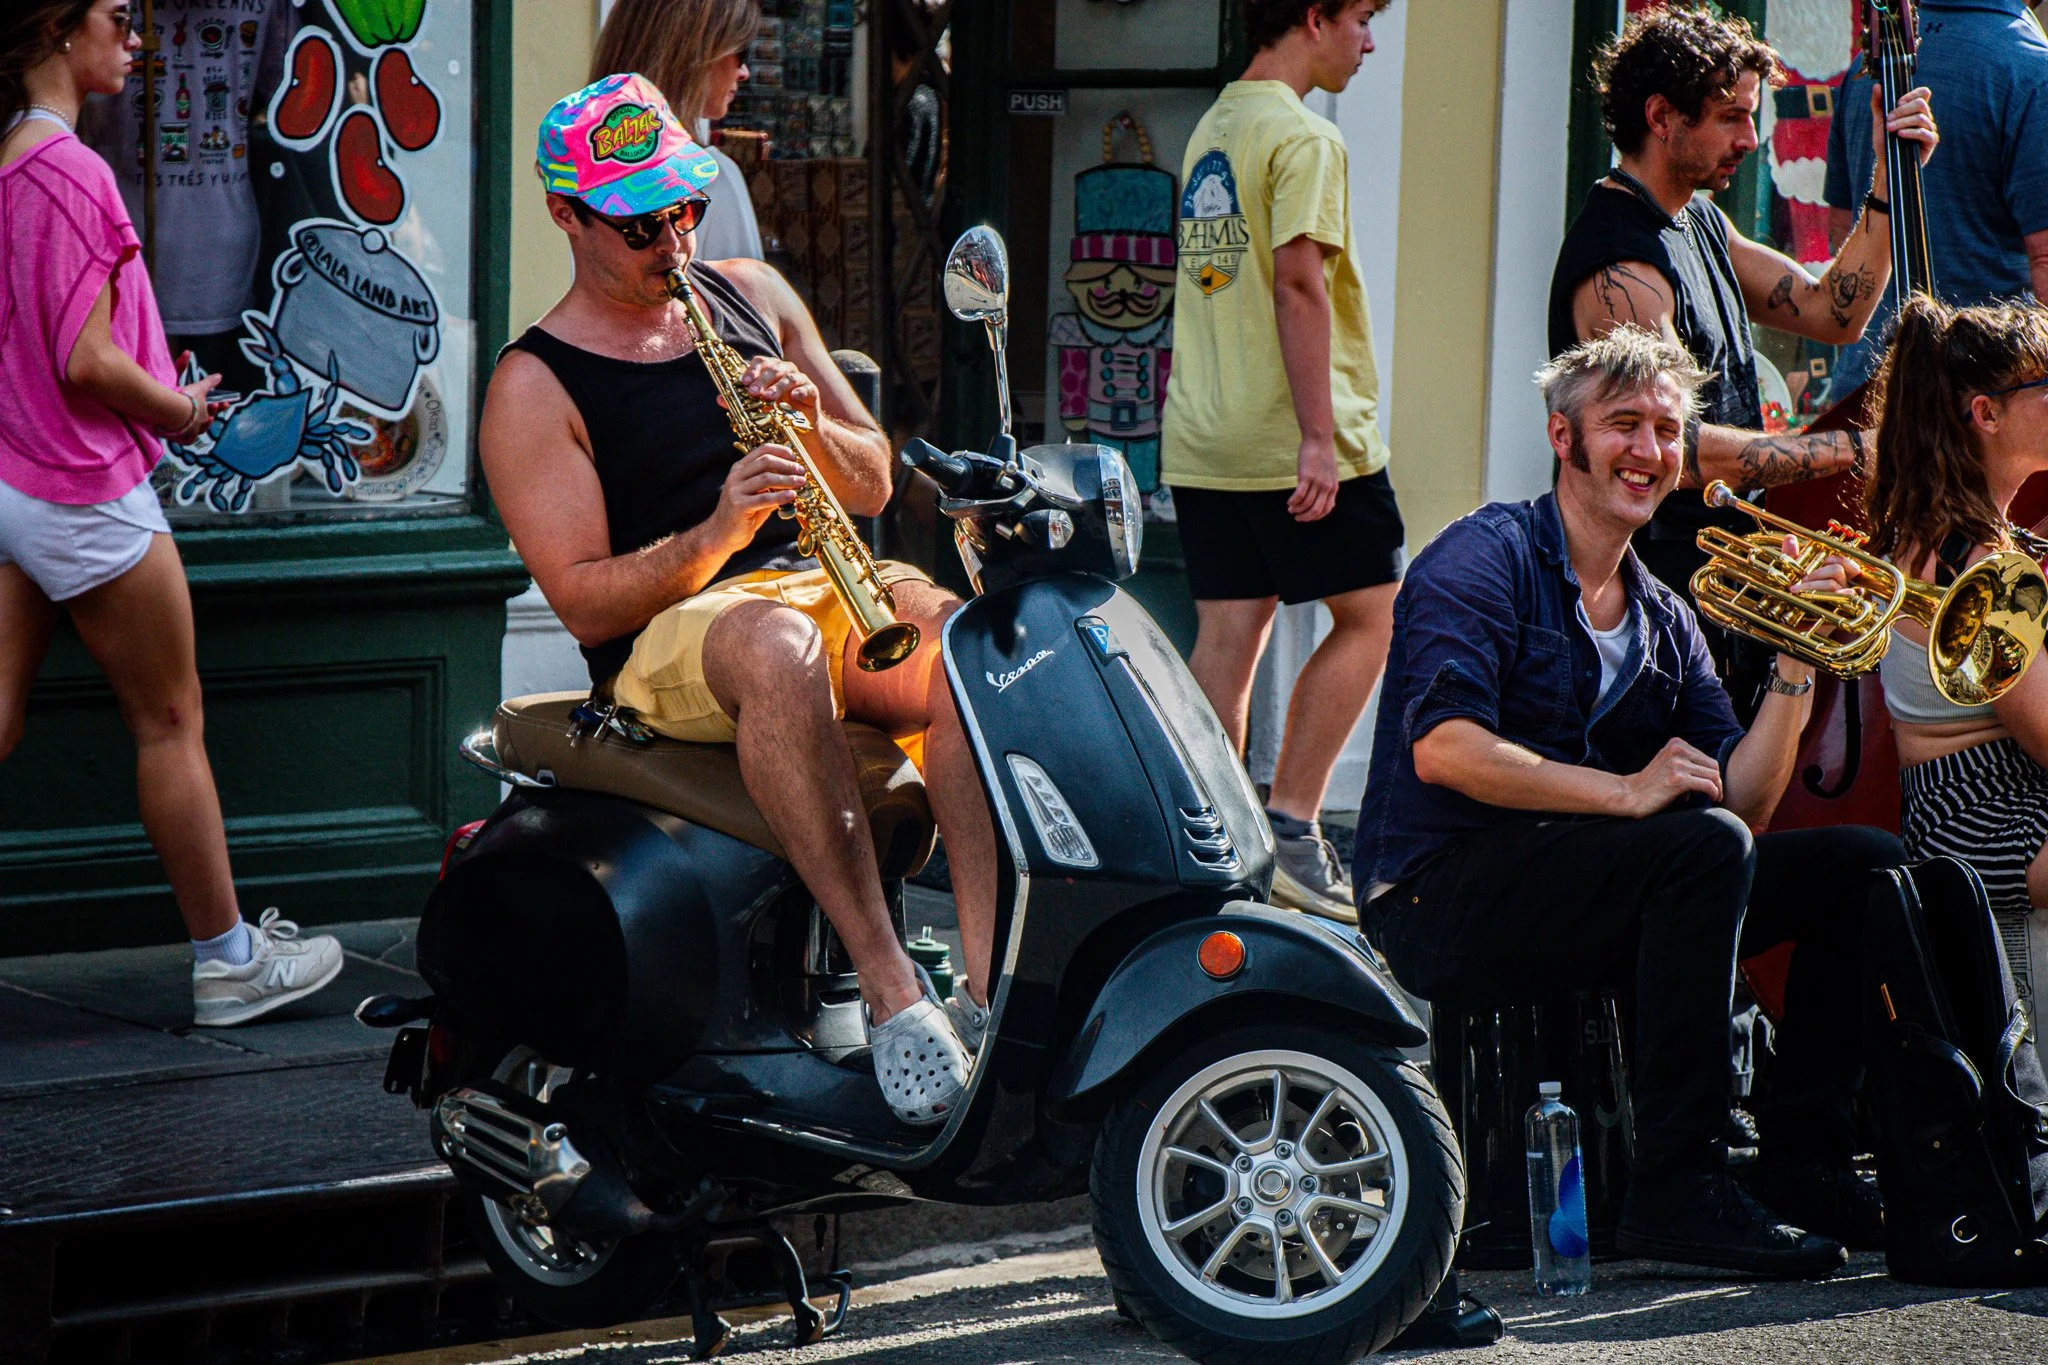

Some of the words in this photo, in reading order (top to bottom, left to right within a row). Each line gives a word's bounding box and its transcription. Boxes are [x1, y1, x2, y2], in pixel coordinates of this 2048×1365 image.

[1010, 94, 1062, 110] PUSH
[596, 109, 661, 158] BALZAC
[352, 274, 396, 309] LAND
[400, 294, 430, 317] ART
[985, 649, 1055, 693] Vespa
[266, 958, 298, 988] N
